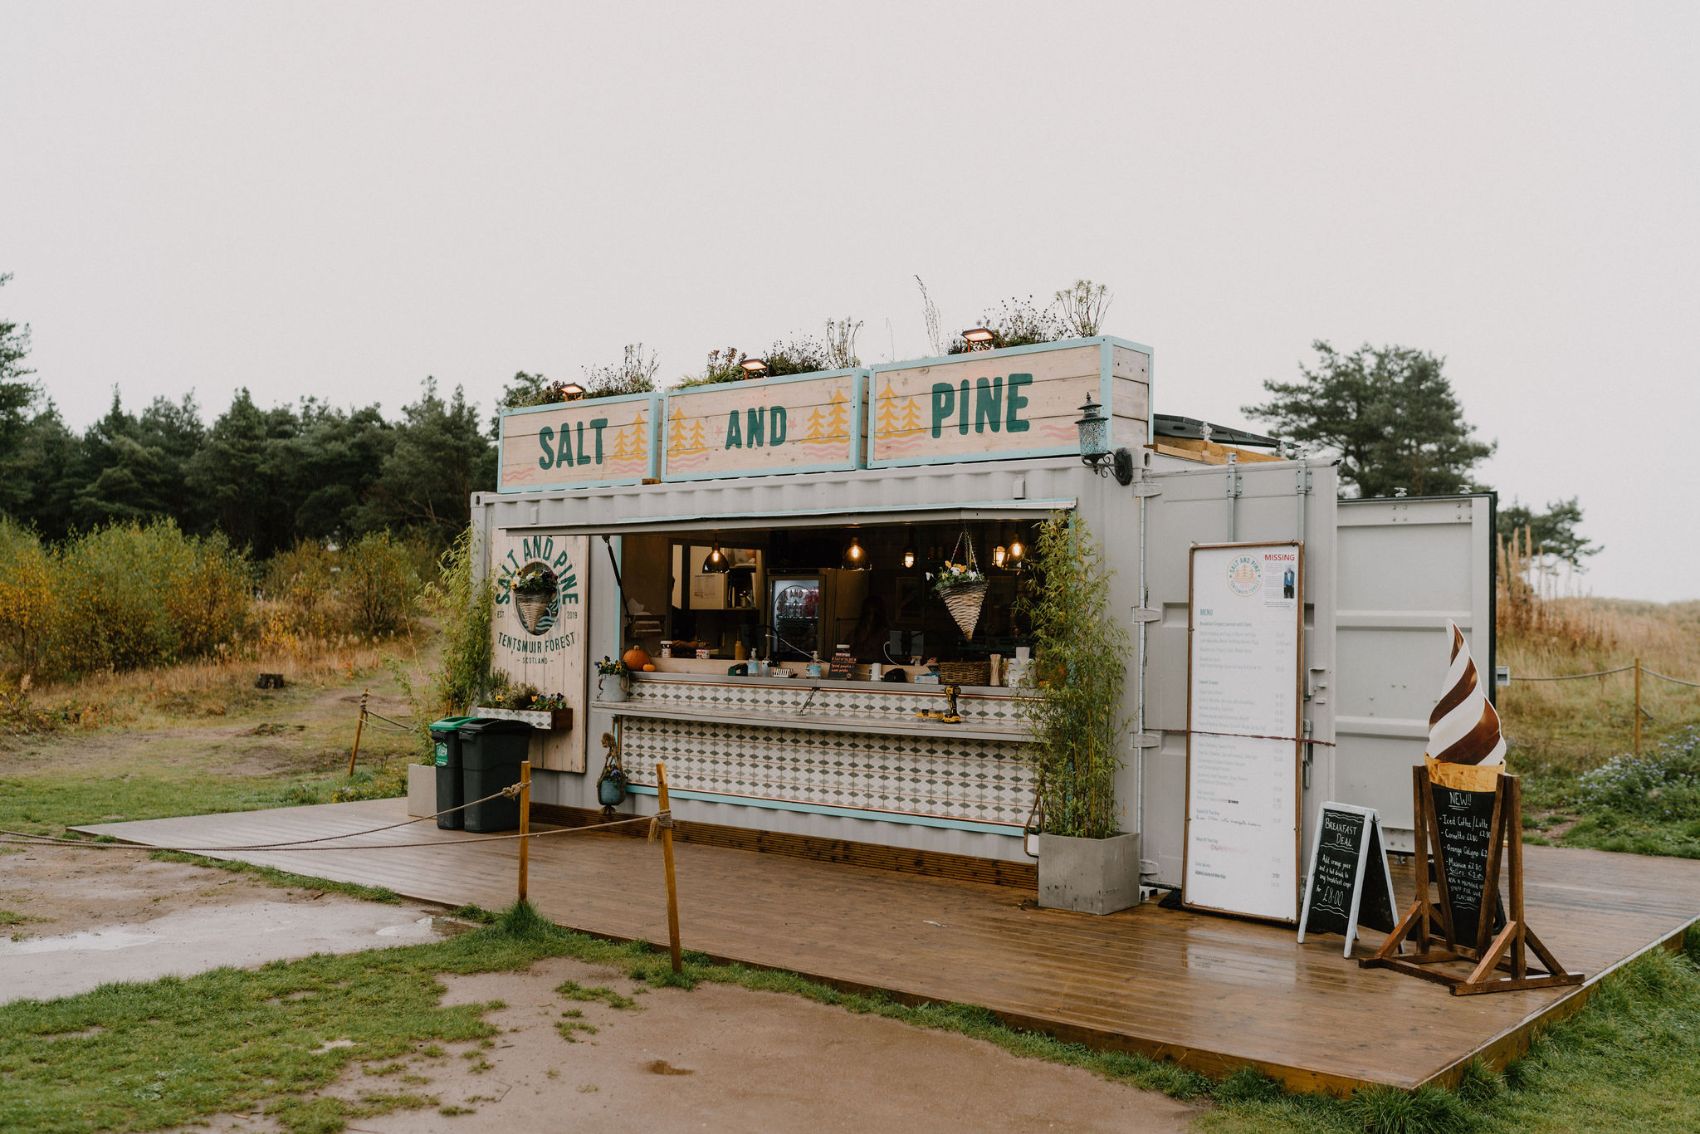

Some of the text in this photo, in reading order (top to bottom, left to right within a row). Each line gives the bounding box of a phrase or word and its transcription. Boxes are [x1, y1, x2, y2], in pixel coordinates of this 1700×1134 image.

[538, 372, 1033, 471] SALT AND PINE
[523, 535, 554, 561] AND
[553, 550, 579, 605] PINE
[567, 611, 577, 619] 2019
[498, 632, 575, 653] TENTSMUIR FOREST
[522, 657, 548, 665] SCOTLAND
[1325, 818, 1357, 835] BREAKFAST
[1336, 833, 1352, 847] DEAL
